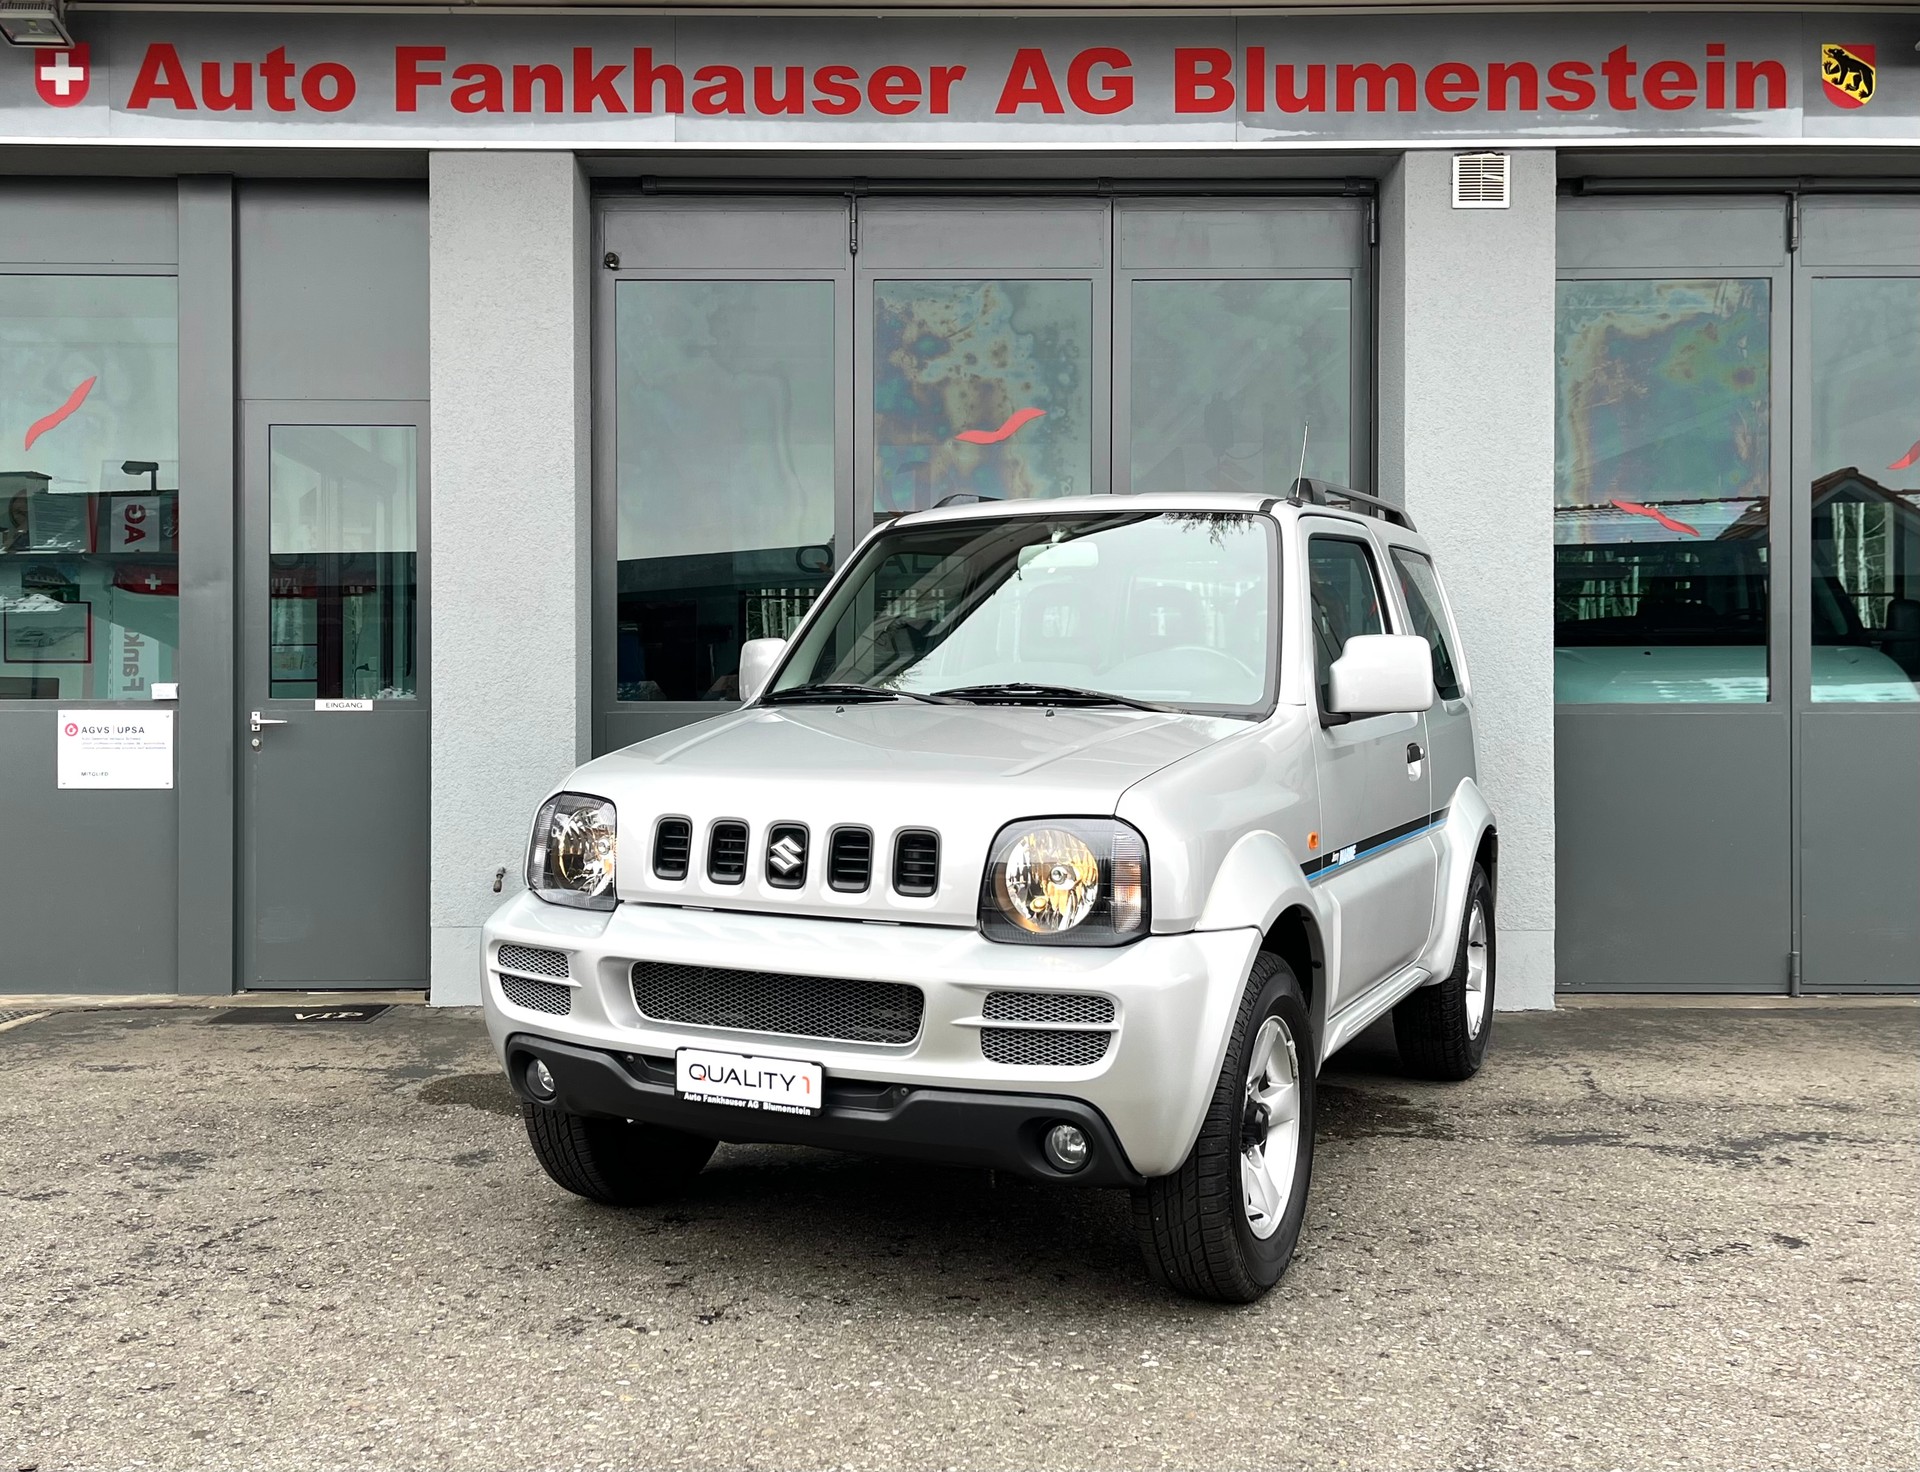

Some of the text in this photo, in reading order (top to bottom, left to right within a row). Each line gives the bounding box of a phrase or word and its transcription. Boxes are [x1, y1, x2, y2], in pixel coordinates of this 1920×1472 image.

[126, 43, 1787, 115] Auto Fankhauser AG Blumenstein
[81, 726, 145, 734] AGVS UPSA
[295, 1011, 364, 1020] VIP
[689, 1063, 810, 1094] QUALITY 1
[684, 1091, 811, 1116] Auto Fankhauser AG Blumenstein
